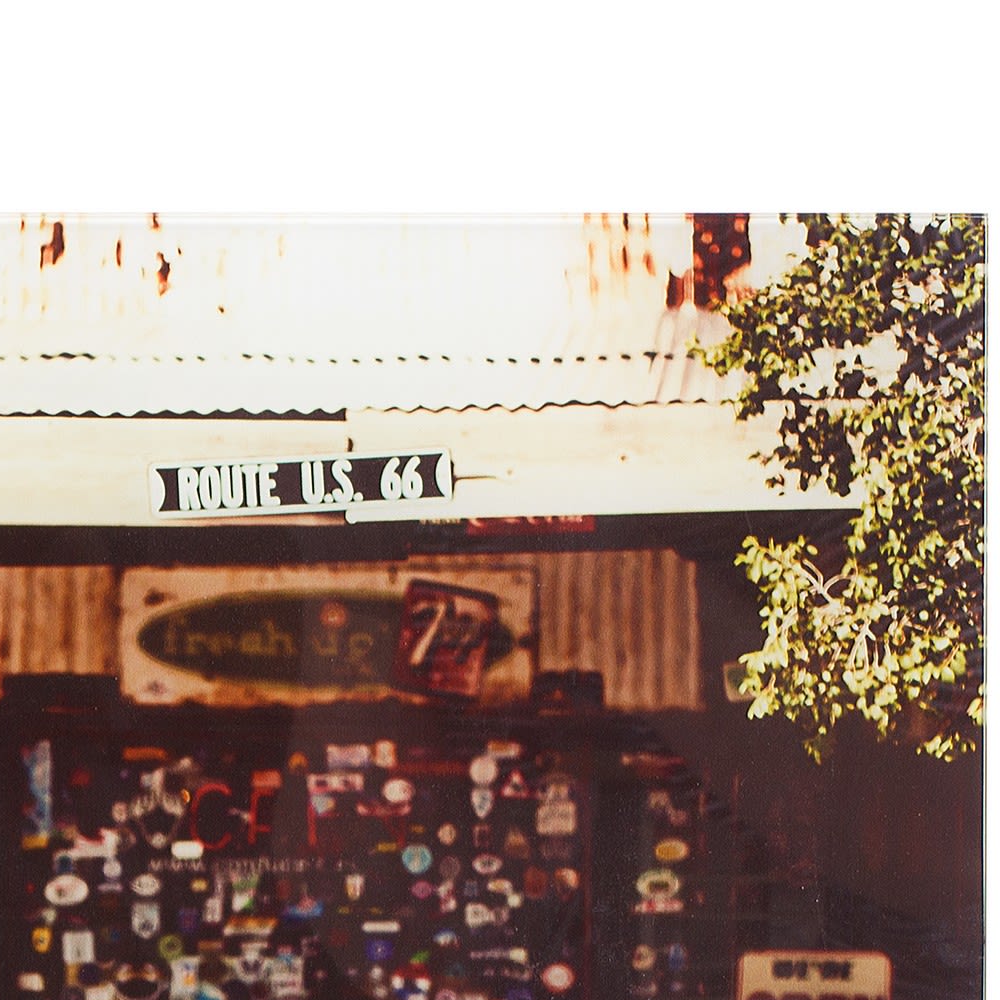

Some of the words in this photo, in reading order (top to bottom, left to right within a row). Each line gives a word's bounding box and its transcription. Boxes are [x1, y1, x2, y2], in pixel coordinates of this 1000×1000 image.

[177, 462, 281, 511] ROUTE
[300, 457, 364, 505] U.S.
[380, 455, 424, 501] 66
